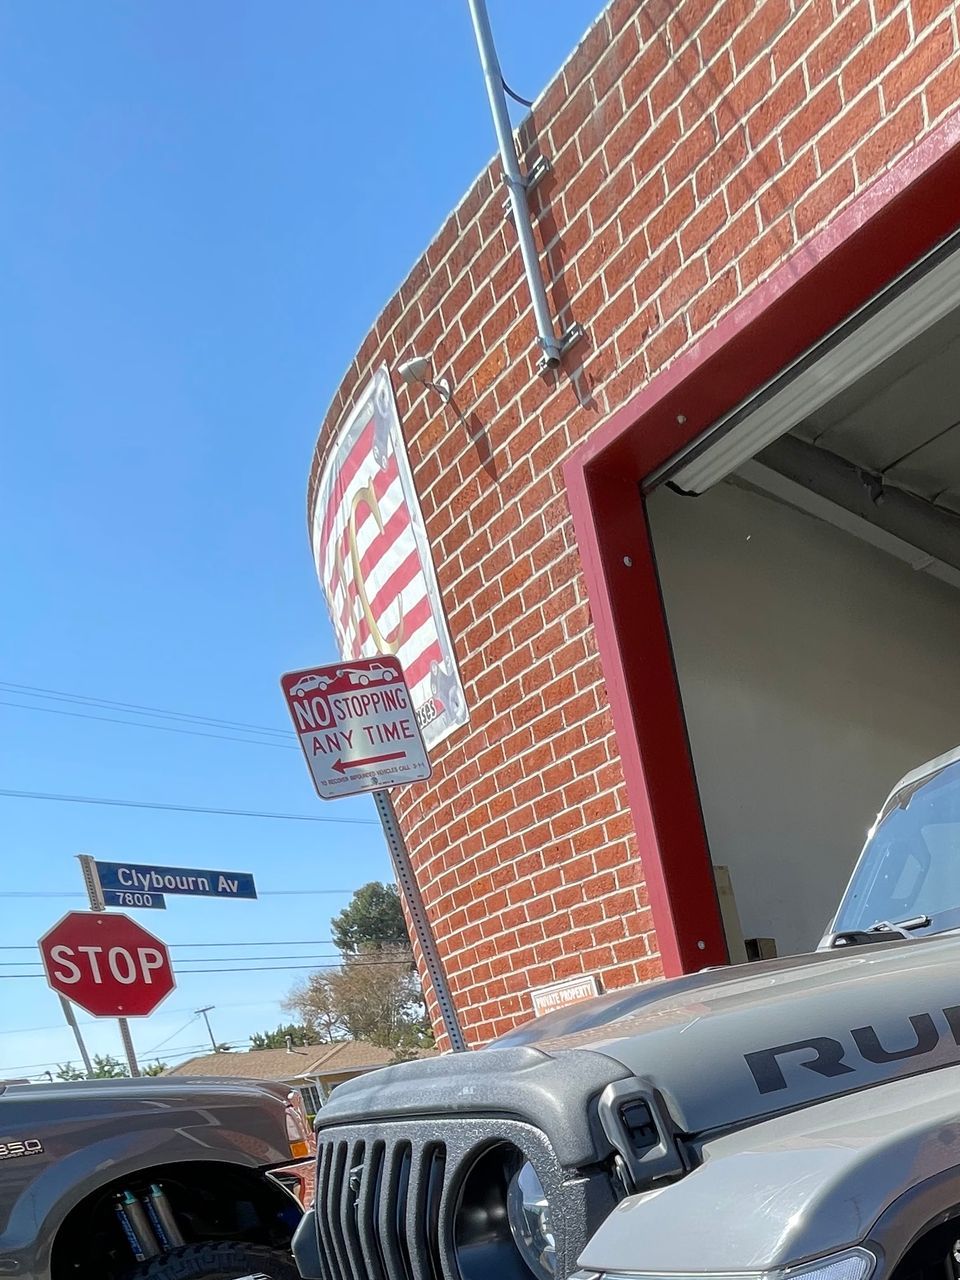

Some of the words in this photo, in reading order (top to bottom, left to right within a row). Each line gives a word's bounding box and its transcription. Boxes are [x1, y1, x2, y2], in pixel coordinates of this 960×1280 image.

[293, 696, 331, 730] NO
[333, 687, 408, 721] STOPPING
[312, 729, 353, 757] ANY
[362, 719, 415, 746] TIME
[117, 867, 209, 892] Clybourn
[217, 875, 239, 893] Av
[115, 892, 153, 907] 7800
[50, 944, 164, 985] STOP
[560, 983, 592, 1003] PROPERTY
